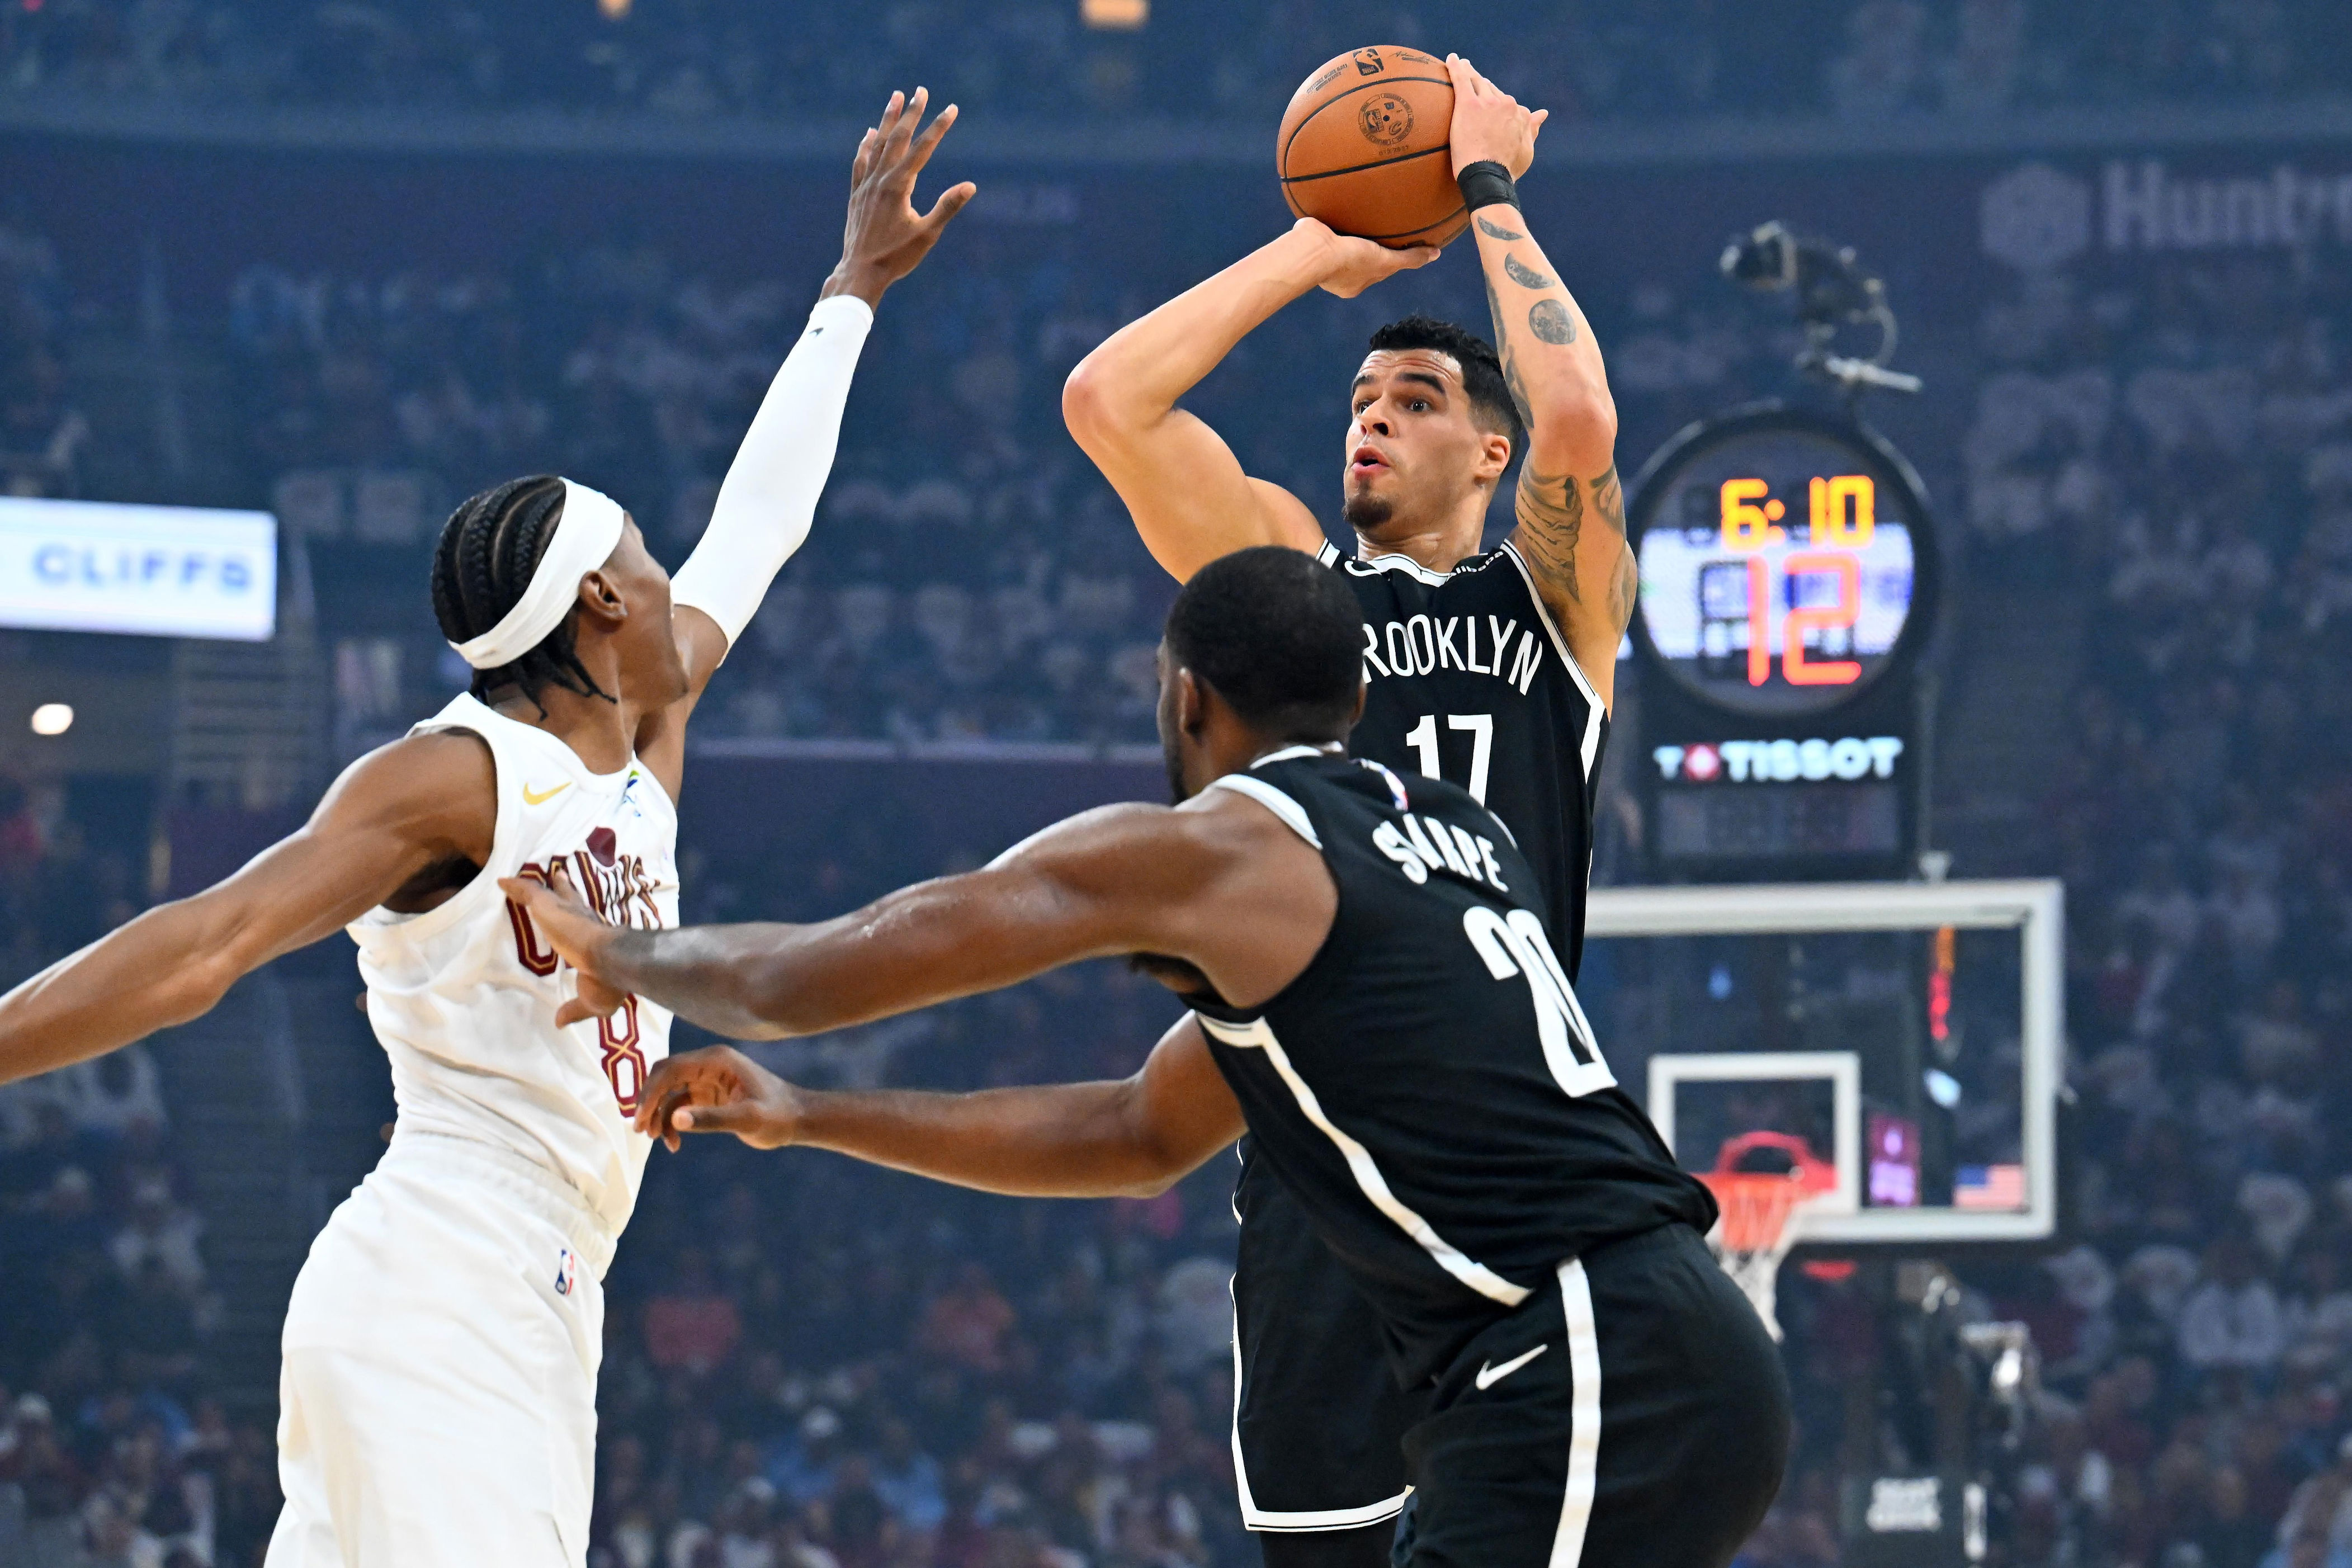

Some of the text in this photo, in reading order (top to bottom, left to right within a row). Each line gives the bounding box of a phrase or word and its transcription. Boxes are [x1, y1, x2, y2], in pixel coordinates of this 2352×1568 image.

[1721, 475, 1875, 551] 6:10
[1362, 614, 1542, 696] ROOKLYN
[1748, 552, 1861, 686] 12
[1406, 714, 1493, 807] 17
[1720, 736, 1904, 782] TISSOT
[1463, 906, 1618, 1098] 20
[598, 992, 648, 1118] 8
